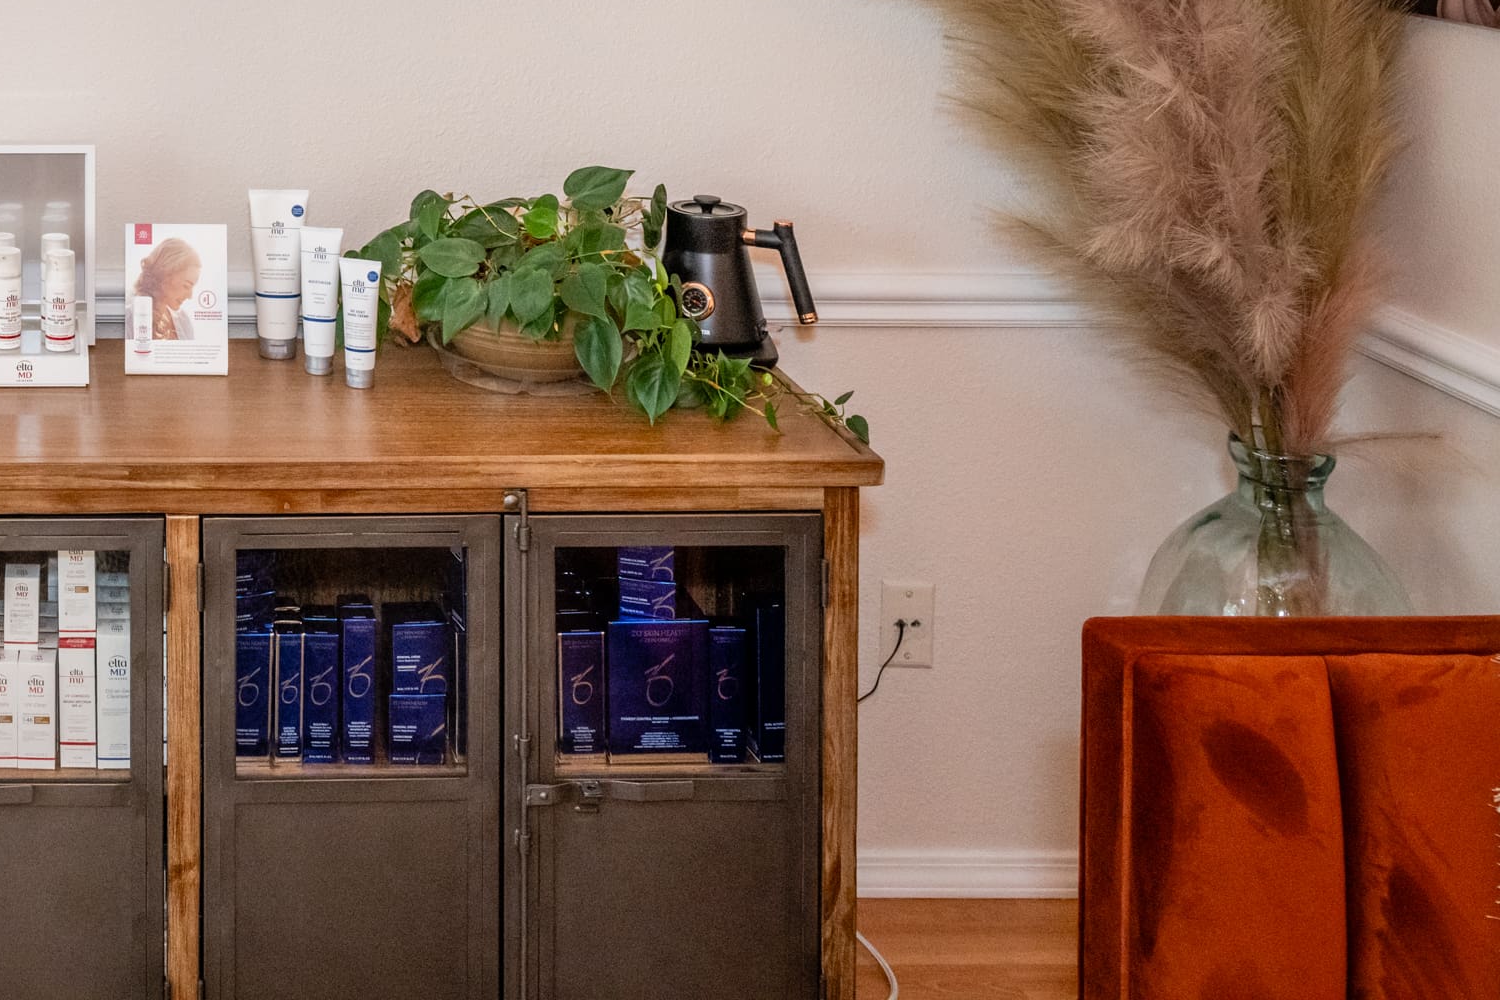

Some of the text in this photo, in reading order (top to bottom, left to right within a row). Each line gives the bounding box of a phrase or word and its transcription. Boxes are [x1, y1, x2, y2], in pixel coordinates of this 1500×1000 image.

[16, 363, 33, 371] elta
[108, 658, 127, 668] elta
[110, 669, 126, 677] MD
[28, 678, 45, 686] elta
